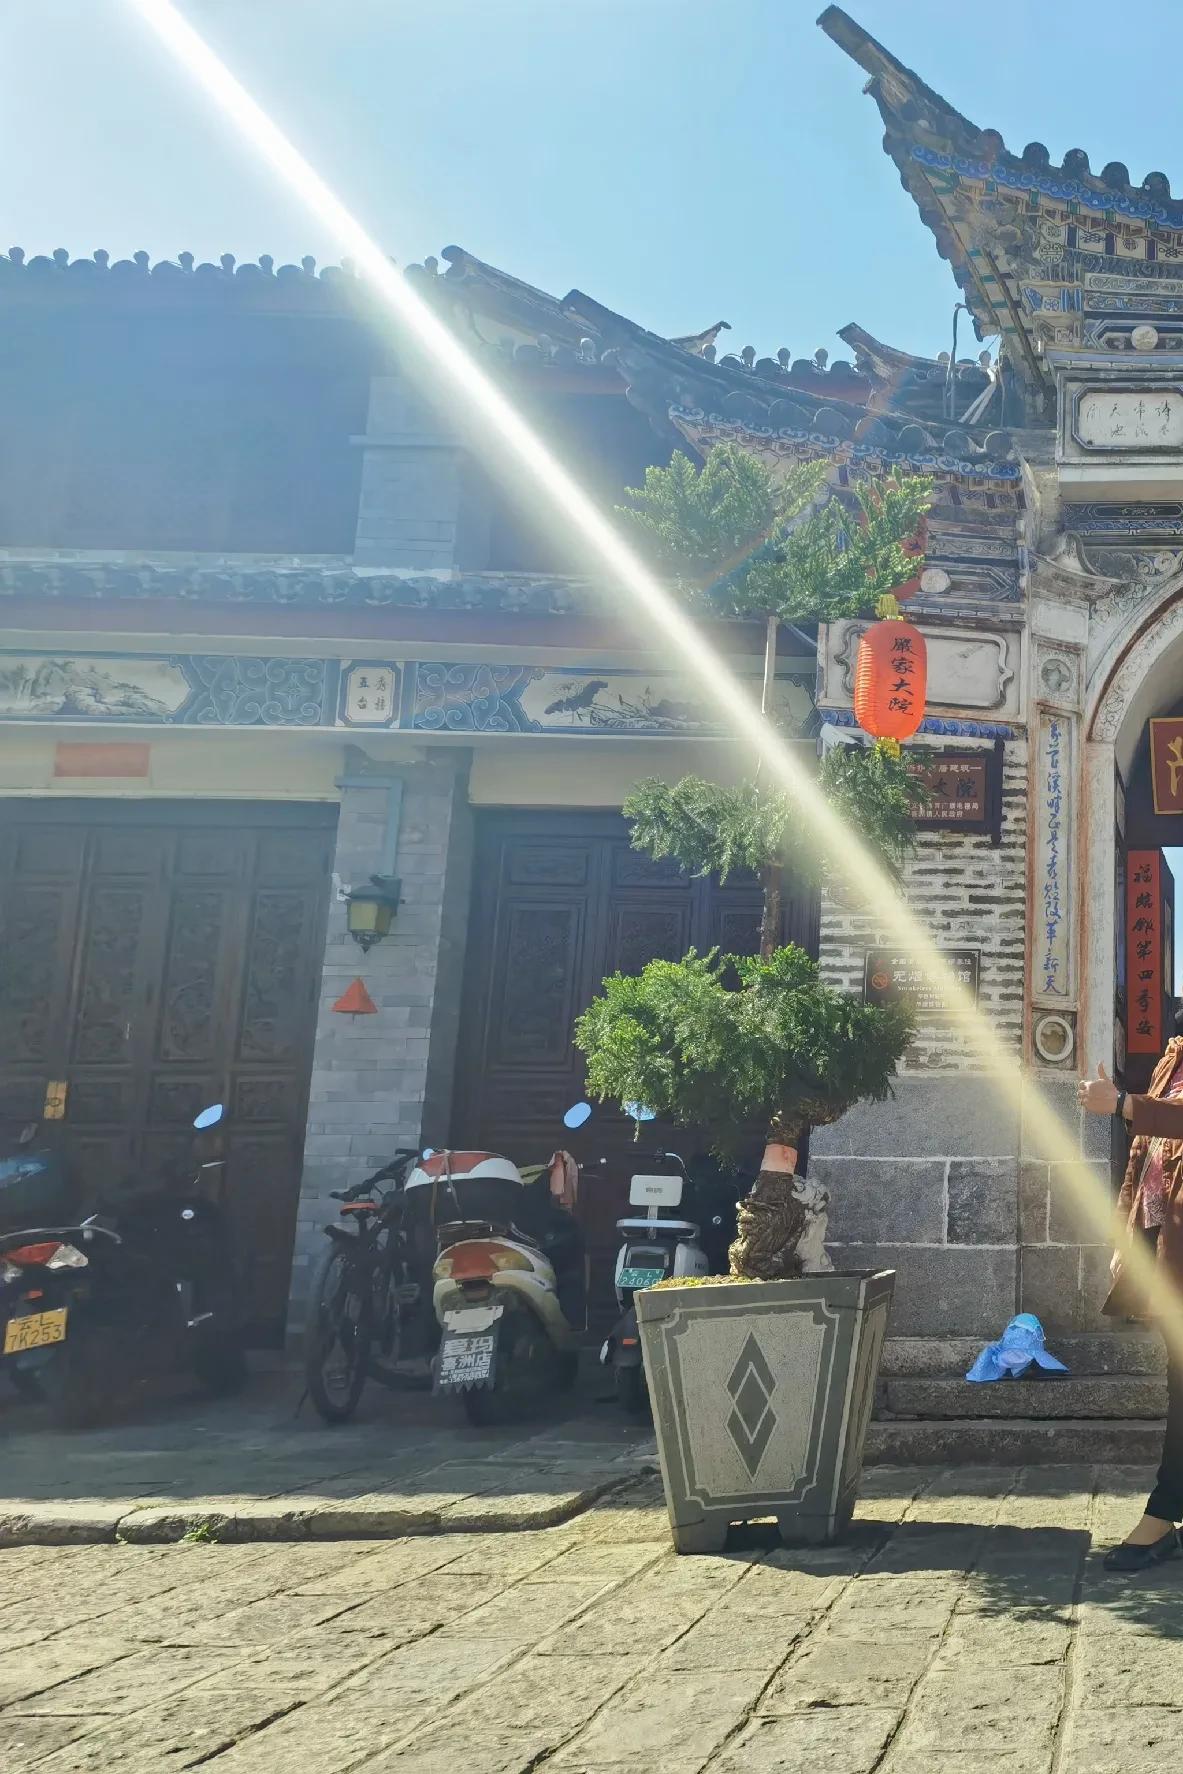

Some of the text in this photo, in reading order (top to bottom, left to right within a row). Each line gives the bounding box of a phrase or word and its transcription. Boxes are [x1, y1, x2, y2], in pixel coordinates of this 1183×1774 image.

[888, 638, 920, 716] 嚴家大院
[8, 1327, 62, 1350] 7K253
